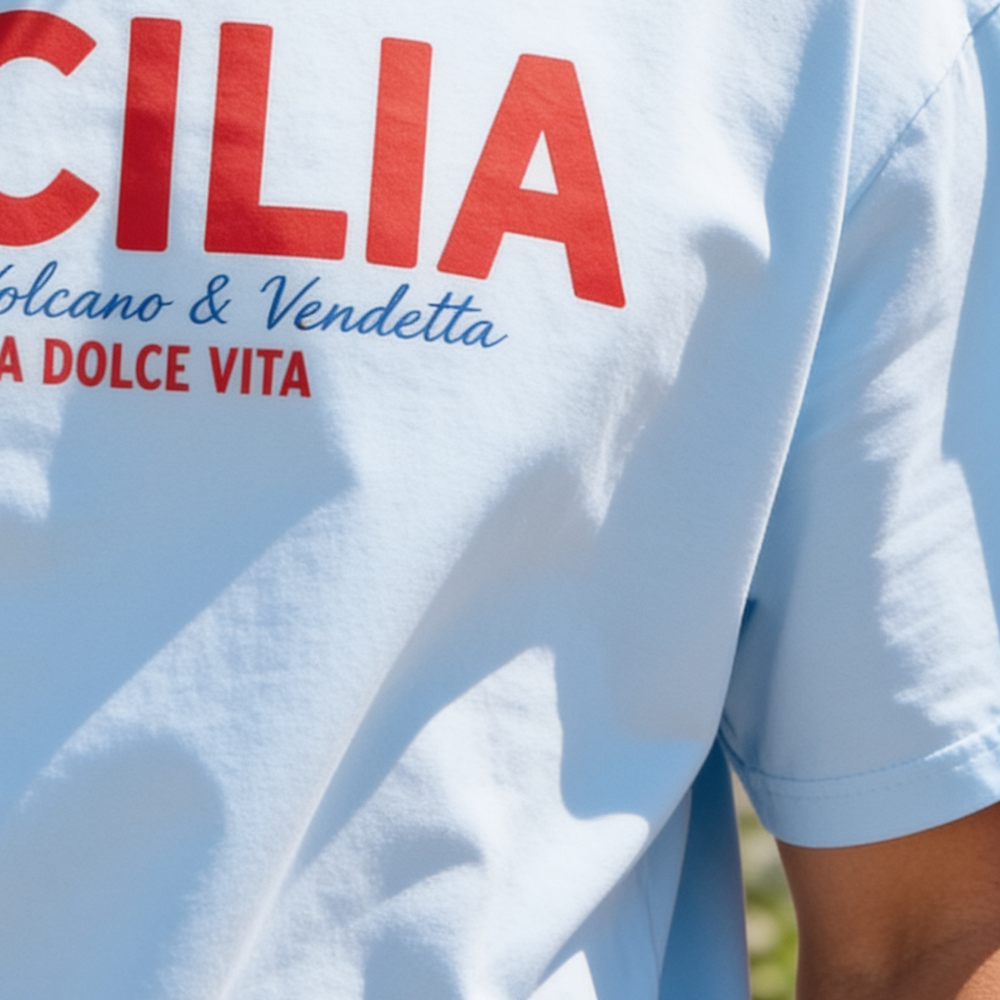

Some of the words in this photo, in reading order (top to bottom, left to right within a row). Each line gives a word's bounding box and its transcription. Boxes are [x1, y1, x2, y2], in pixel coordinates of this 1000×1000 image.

[188, 273, 231, 325] &
[260, 275, 509, 349] Vendetta
[42, 337, 190, 392] DOLCE
[209, 347, 311, 398] VITA
